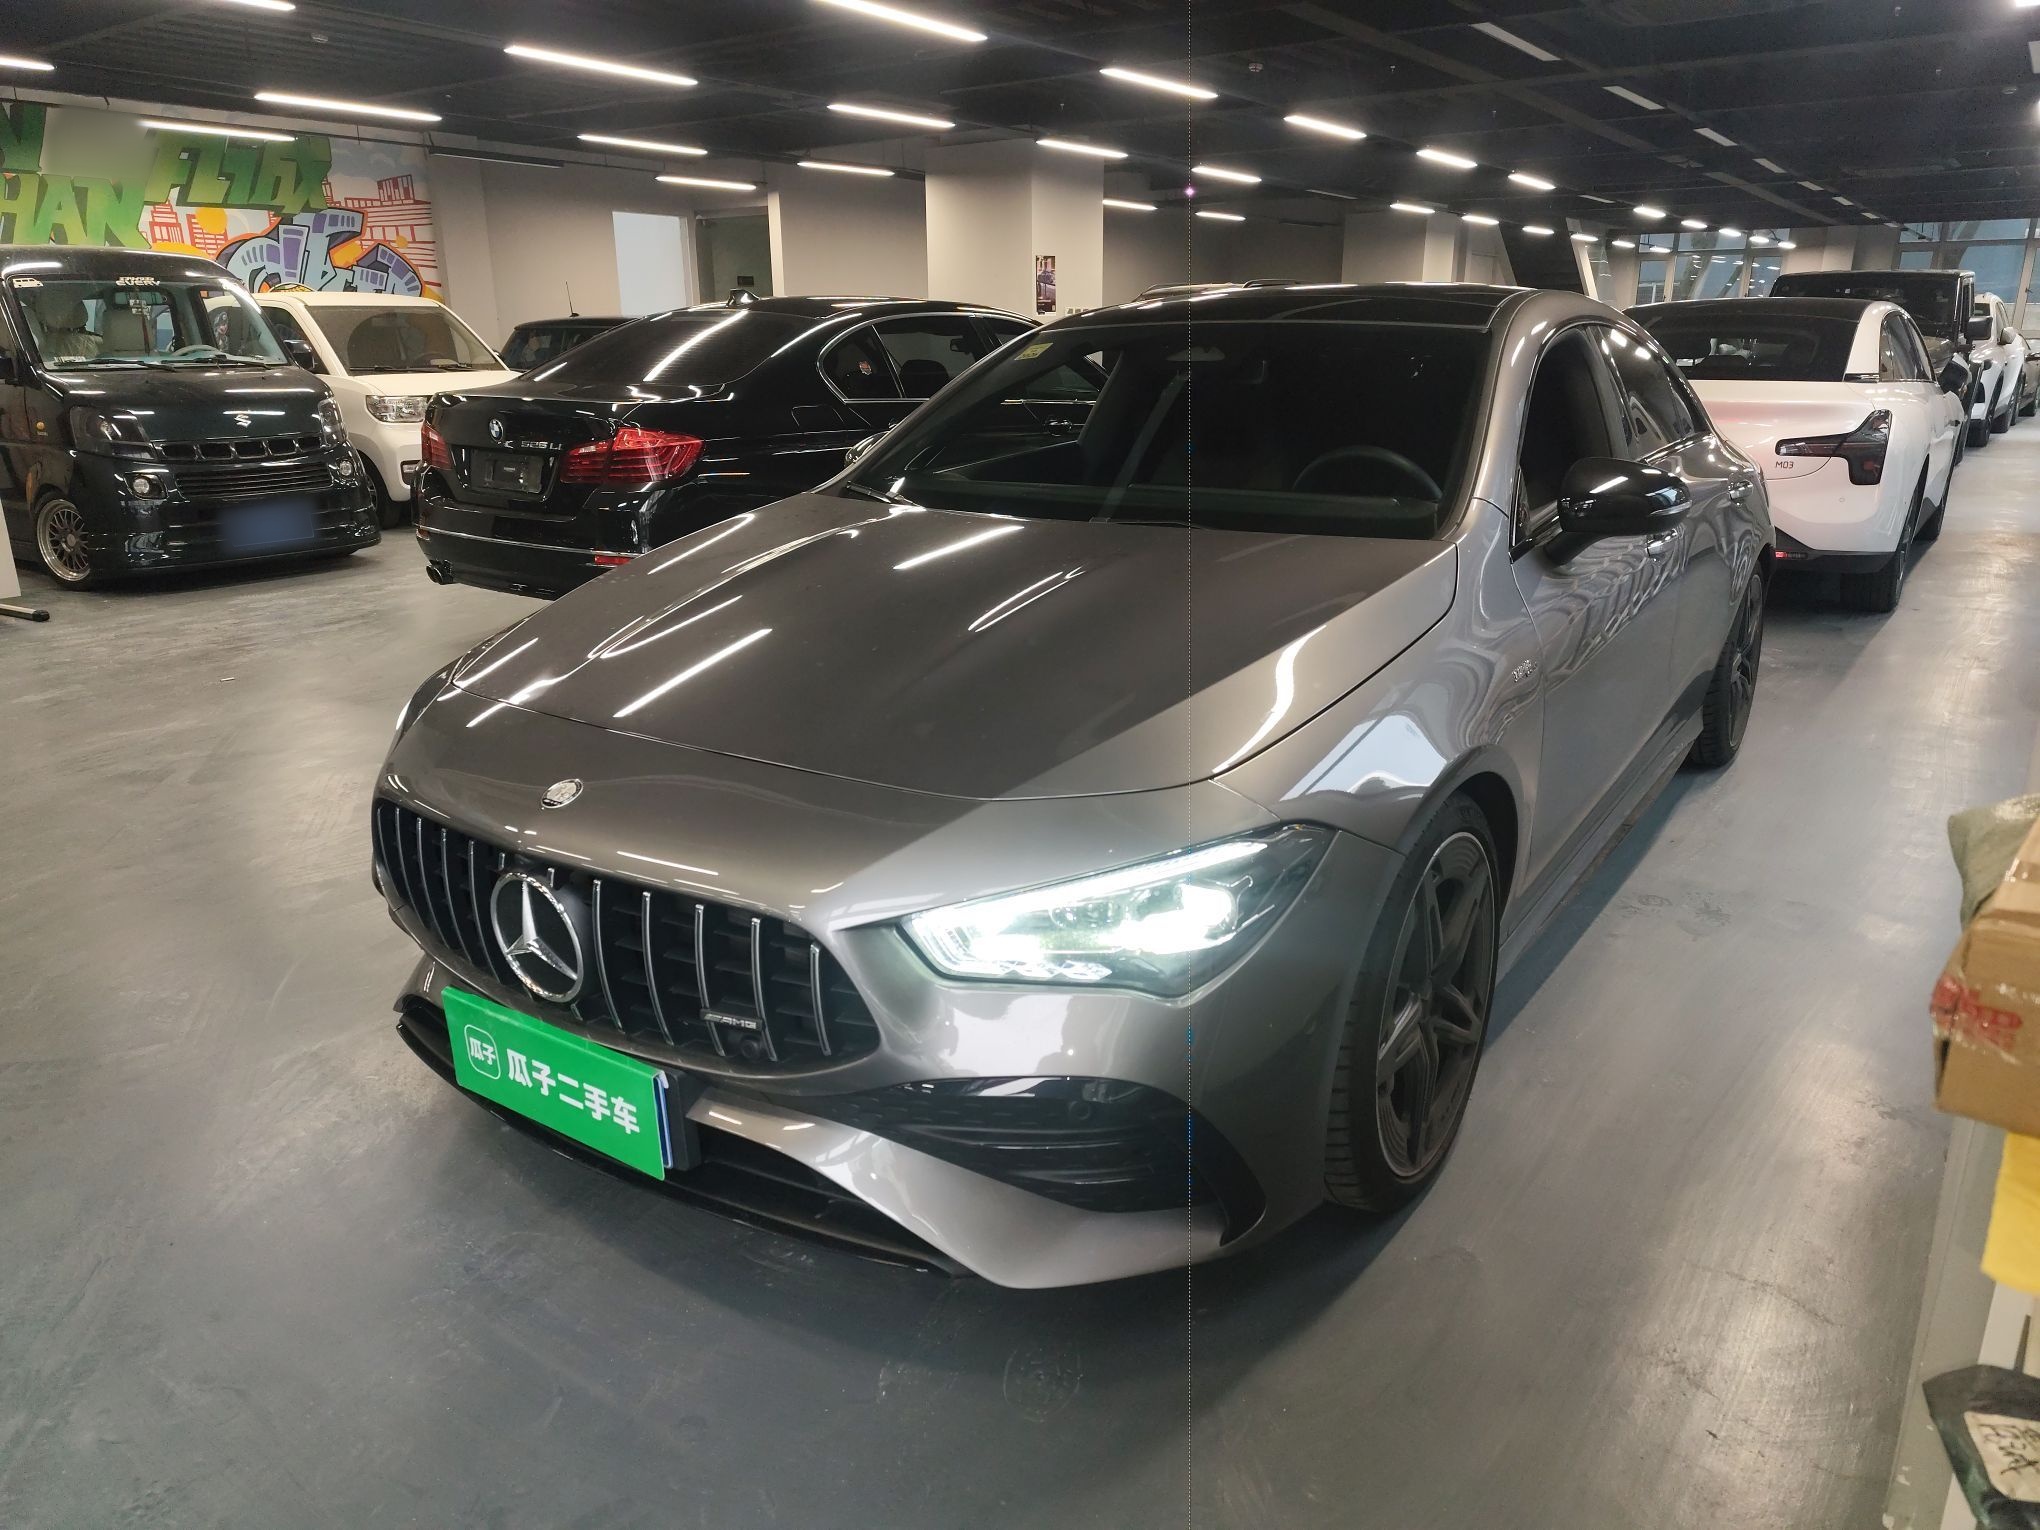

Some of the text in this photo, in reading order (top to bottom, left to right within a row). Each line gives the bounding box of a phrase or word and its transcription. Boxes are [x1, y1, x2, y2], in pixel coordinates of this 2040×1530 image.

[719, 1016, 757, 1029] AMG
[469, 1037, 497, 1065] 瓜子
[506, 1048, 640, 1135] 瓜子二手车
